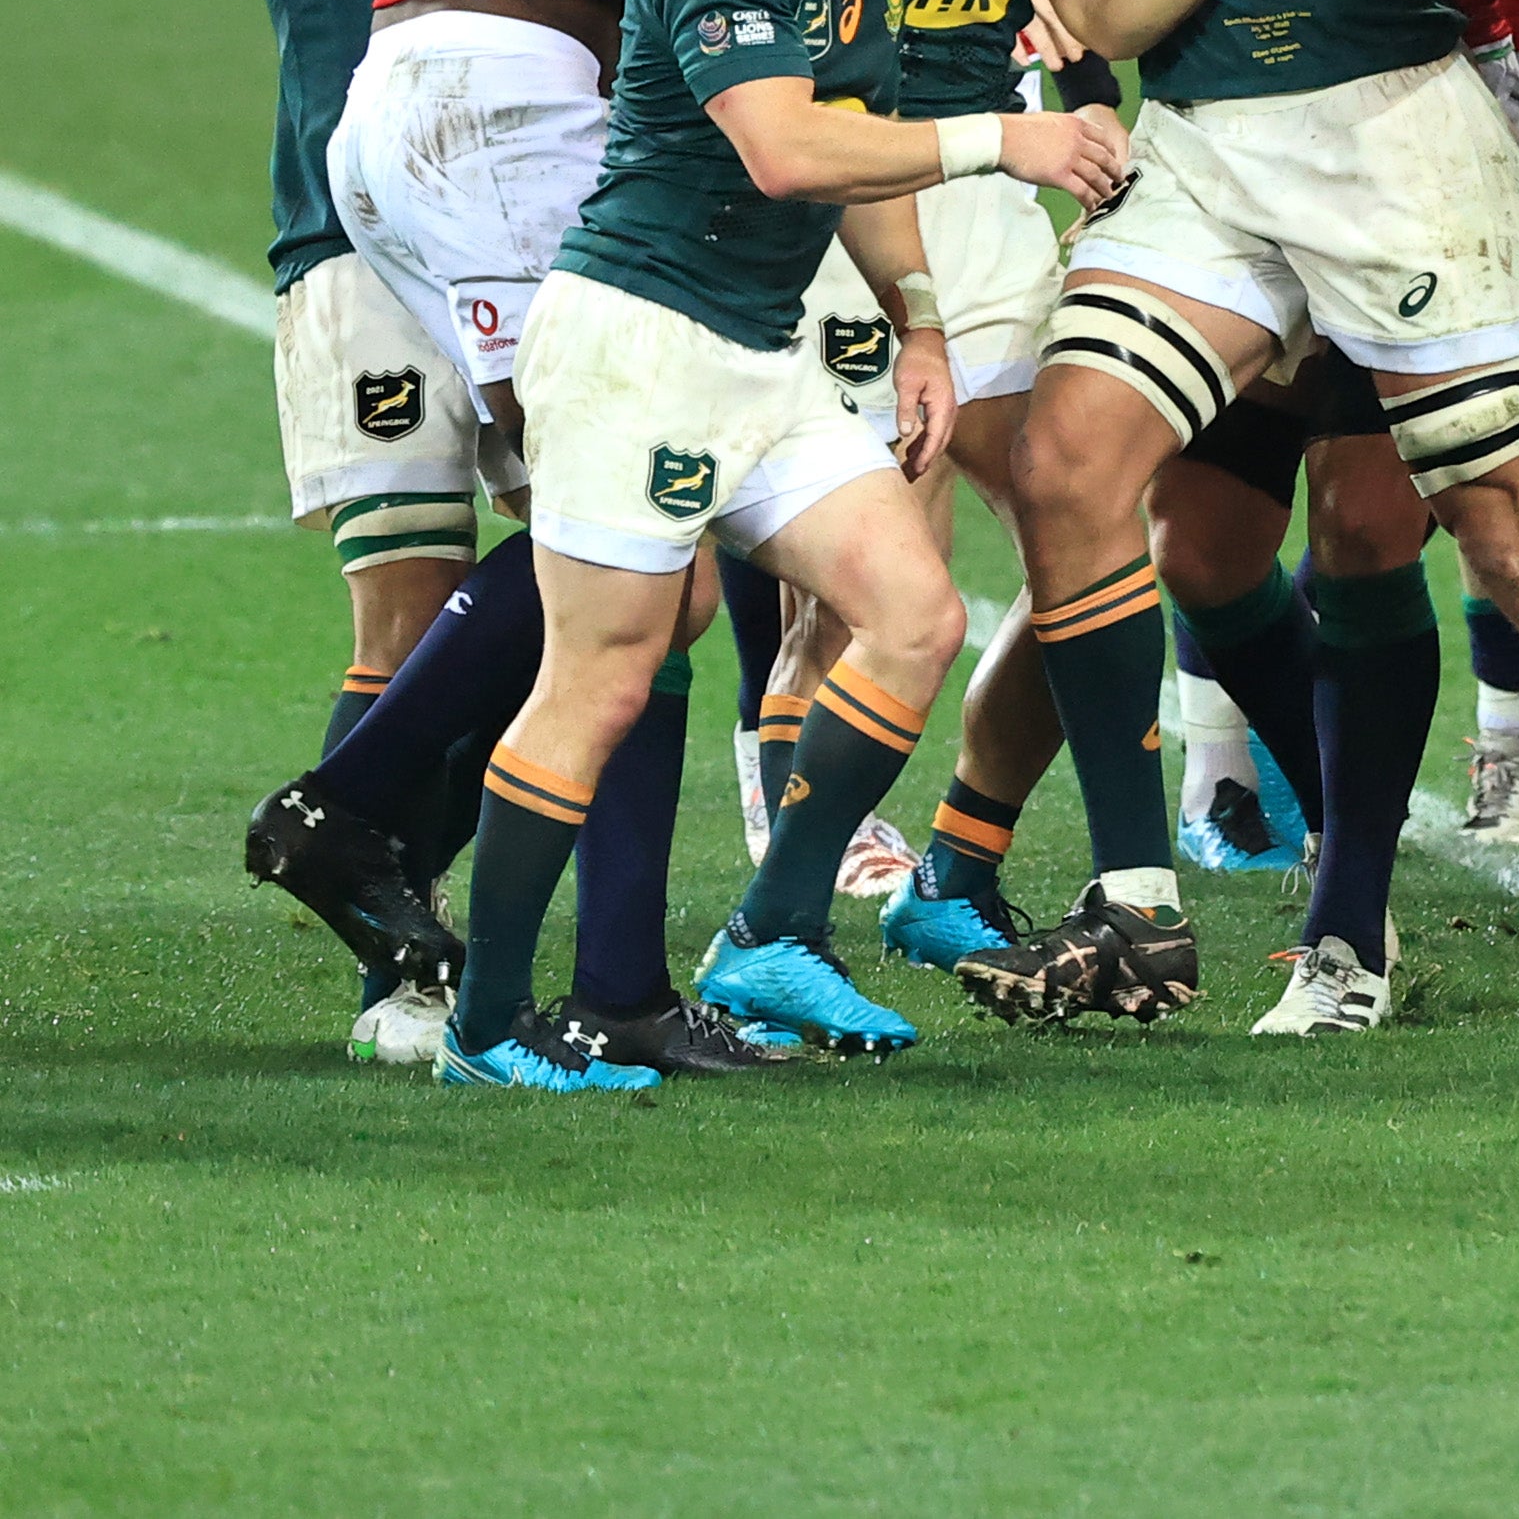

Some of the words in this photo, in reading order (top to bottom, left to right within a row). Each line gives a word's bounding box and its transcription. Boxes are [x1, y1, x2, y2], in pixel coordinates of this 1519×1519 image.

[732, 9, 771, 21] CASTLE
[734, 22, 774, 34] LIONS
[367, 417, 411, 429] SPRINGBOK
